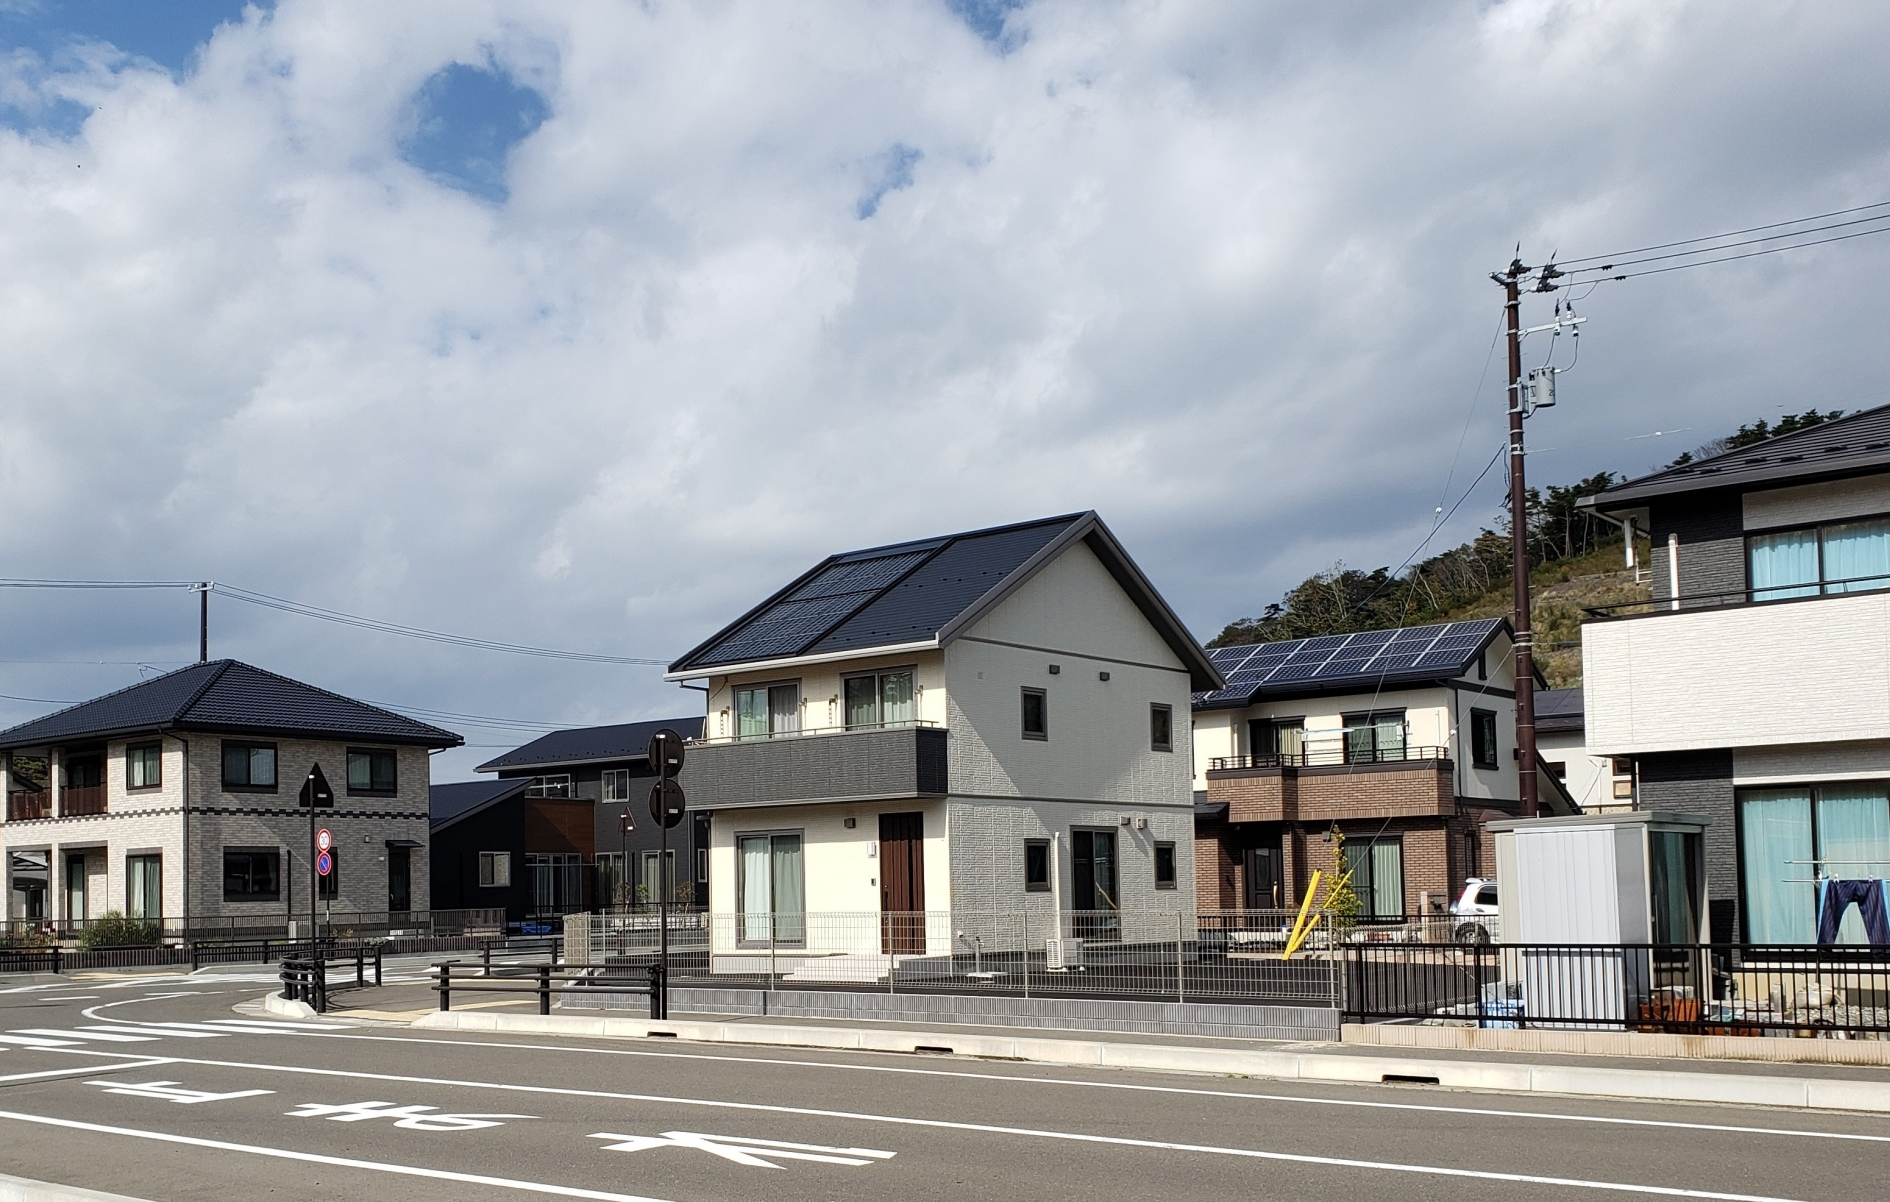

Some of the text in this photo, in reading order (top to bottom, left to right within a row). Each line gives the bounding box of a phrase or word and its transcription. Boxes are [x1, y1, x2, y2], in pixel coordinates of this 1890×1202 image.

[320, 835, 329, 846] 30
[82, 1080, 897, 1170] 止まれ
